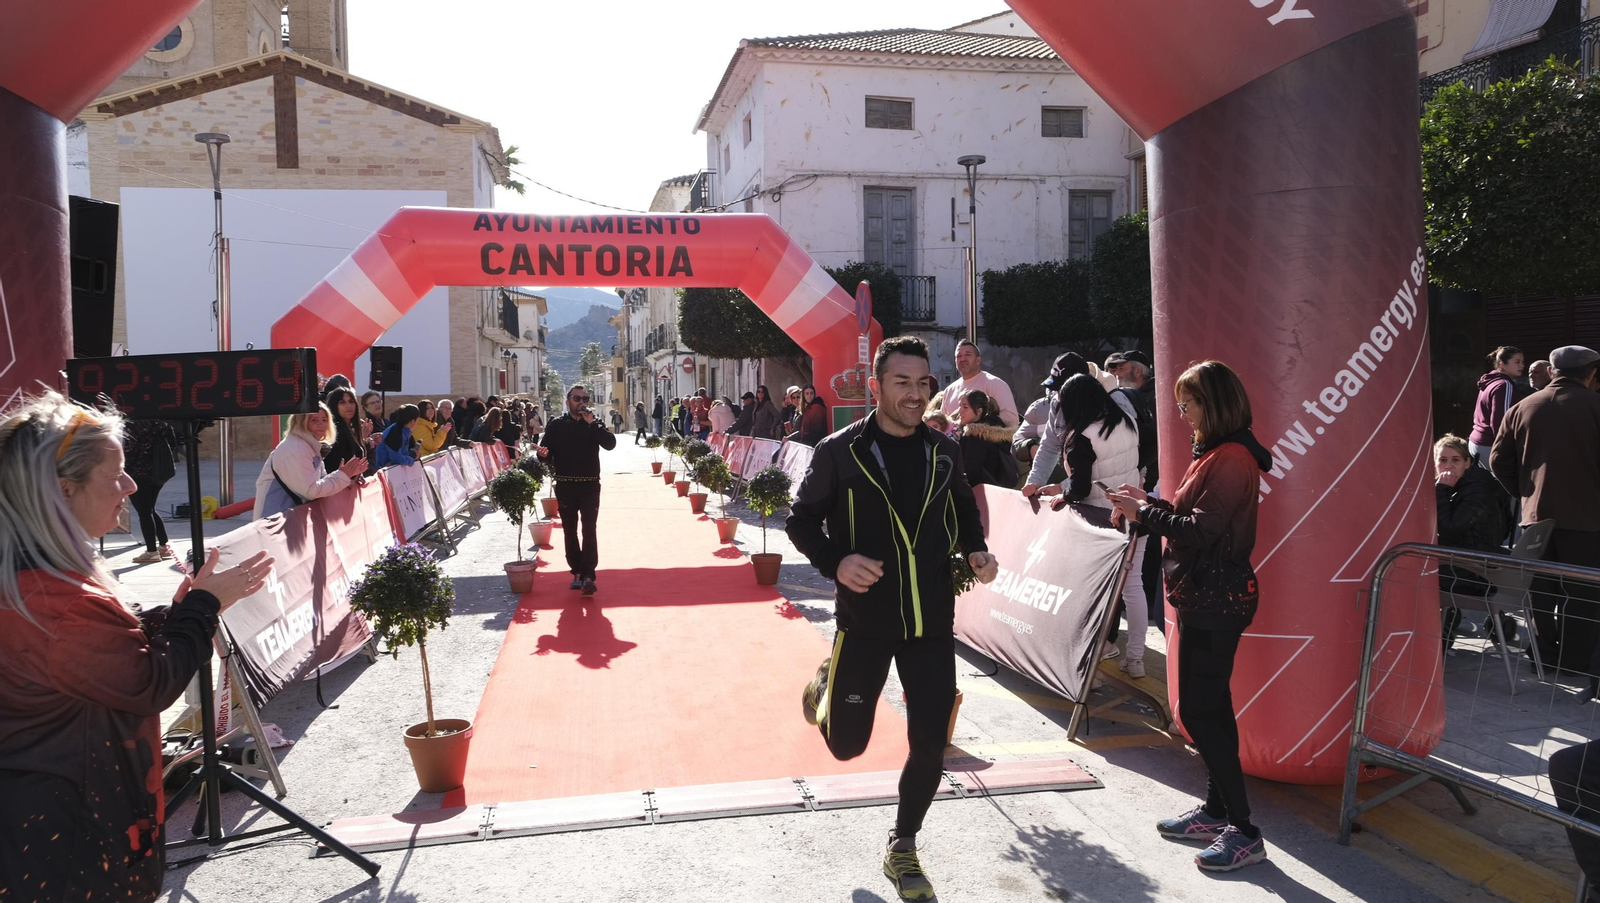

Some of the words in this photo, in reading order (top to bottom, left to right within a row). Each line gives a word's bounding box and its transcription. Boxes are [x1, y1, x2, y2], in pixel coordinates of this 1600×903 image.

[473, 213, 700, 235] AYUNTAMIENTO
[481, 243, 693, 277] CANTORIA
[221, 690, 229, 702] EL
